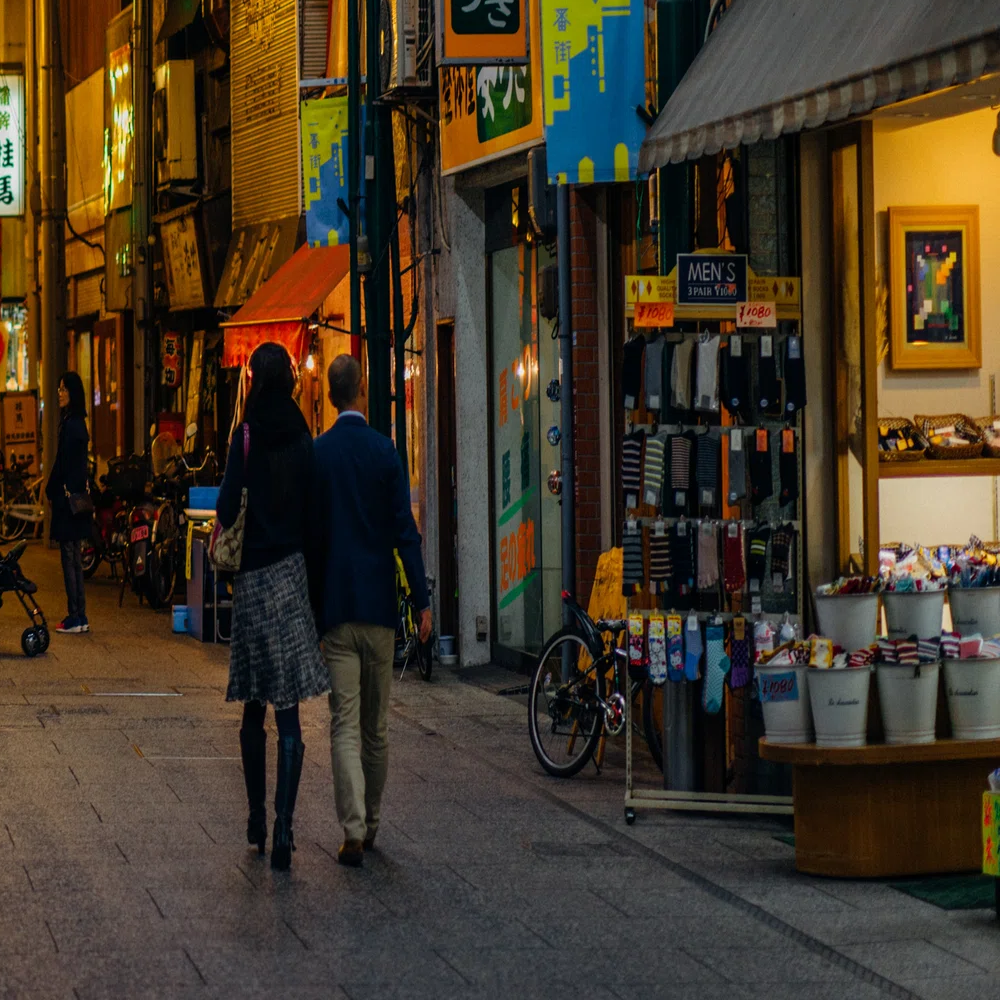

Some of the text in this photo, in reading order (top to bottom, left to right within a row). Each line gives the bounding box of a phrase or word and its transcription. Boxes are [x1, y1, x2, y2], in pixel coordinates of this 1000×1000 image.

[688, 262, 736, 283] MEN'S
[693, 287, 712, 296] PAIR
[739, 302, 772, 322] ¥1080
